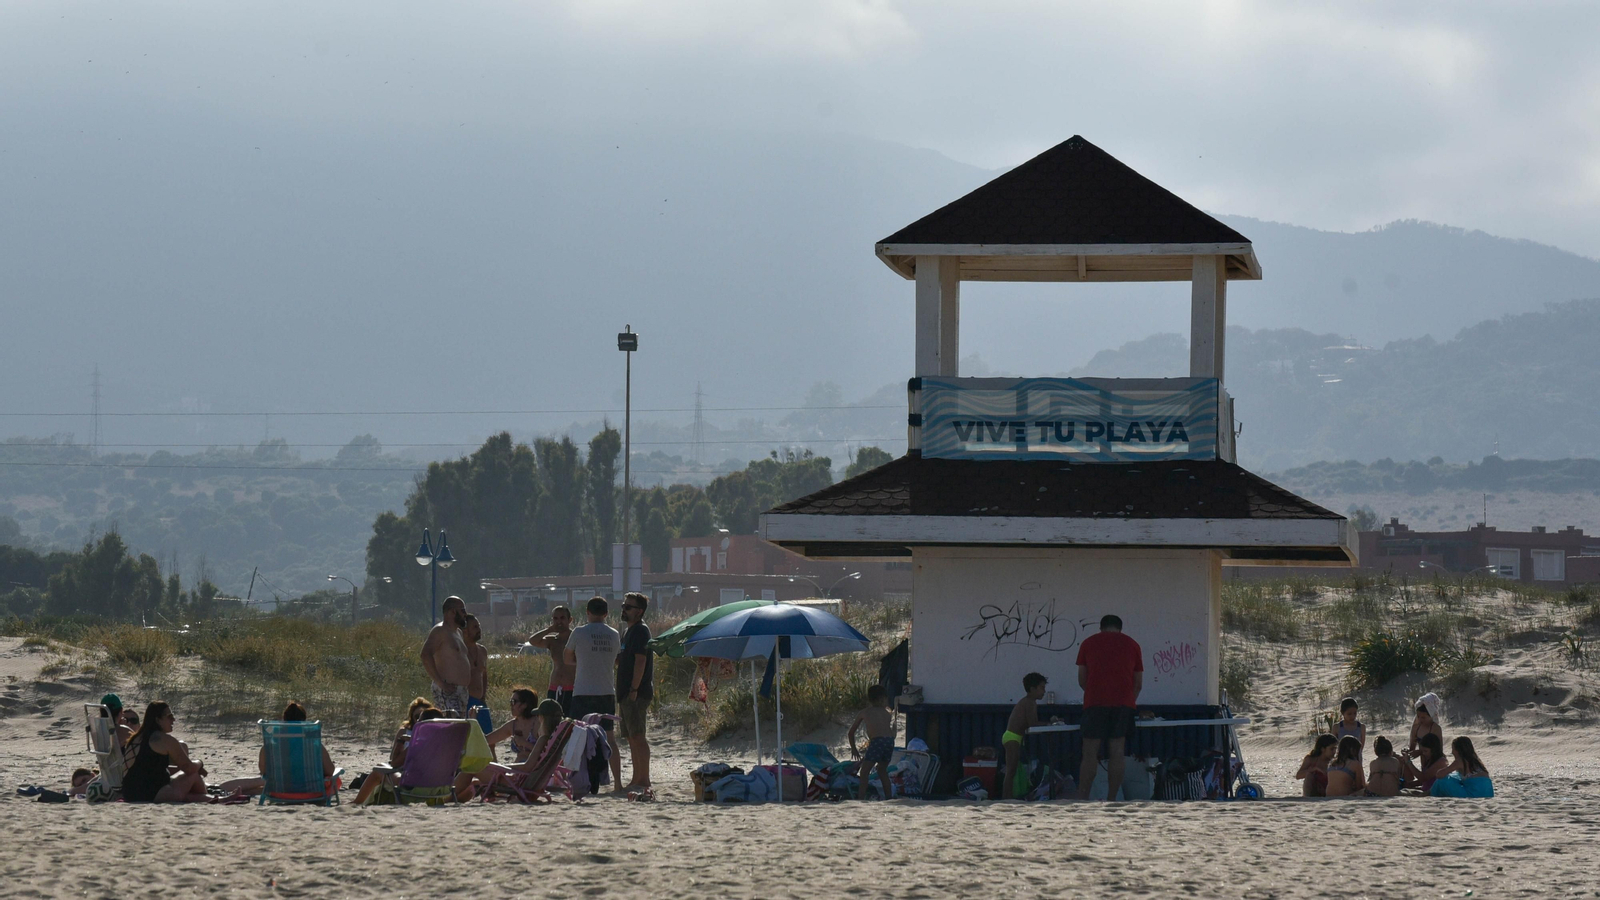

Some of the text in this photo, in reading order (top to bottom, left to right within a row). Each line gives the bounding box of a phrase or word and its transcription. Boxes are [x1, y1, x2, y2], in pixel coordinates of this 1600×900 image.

[952, 421, 1189, 443] VIVE TU PLAYA
